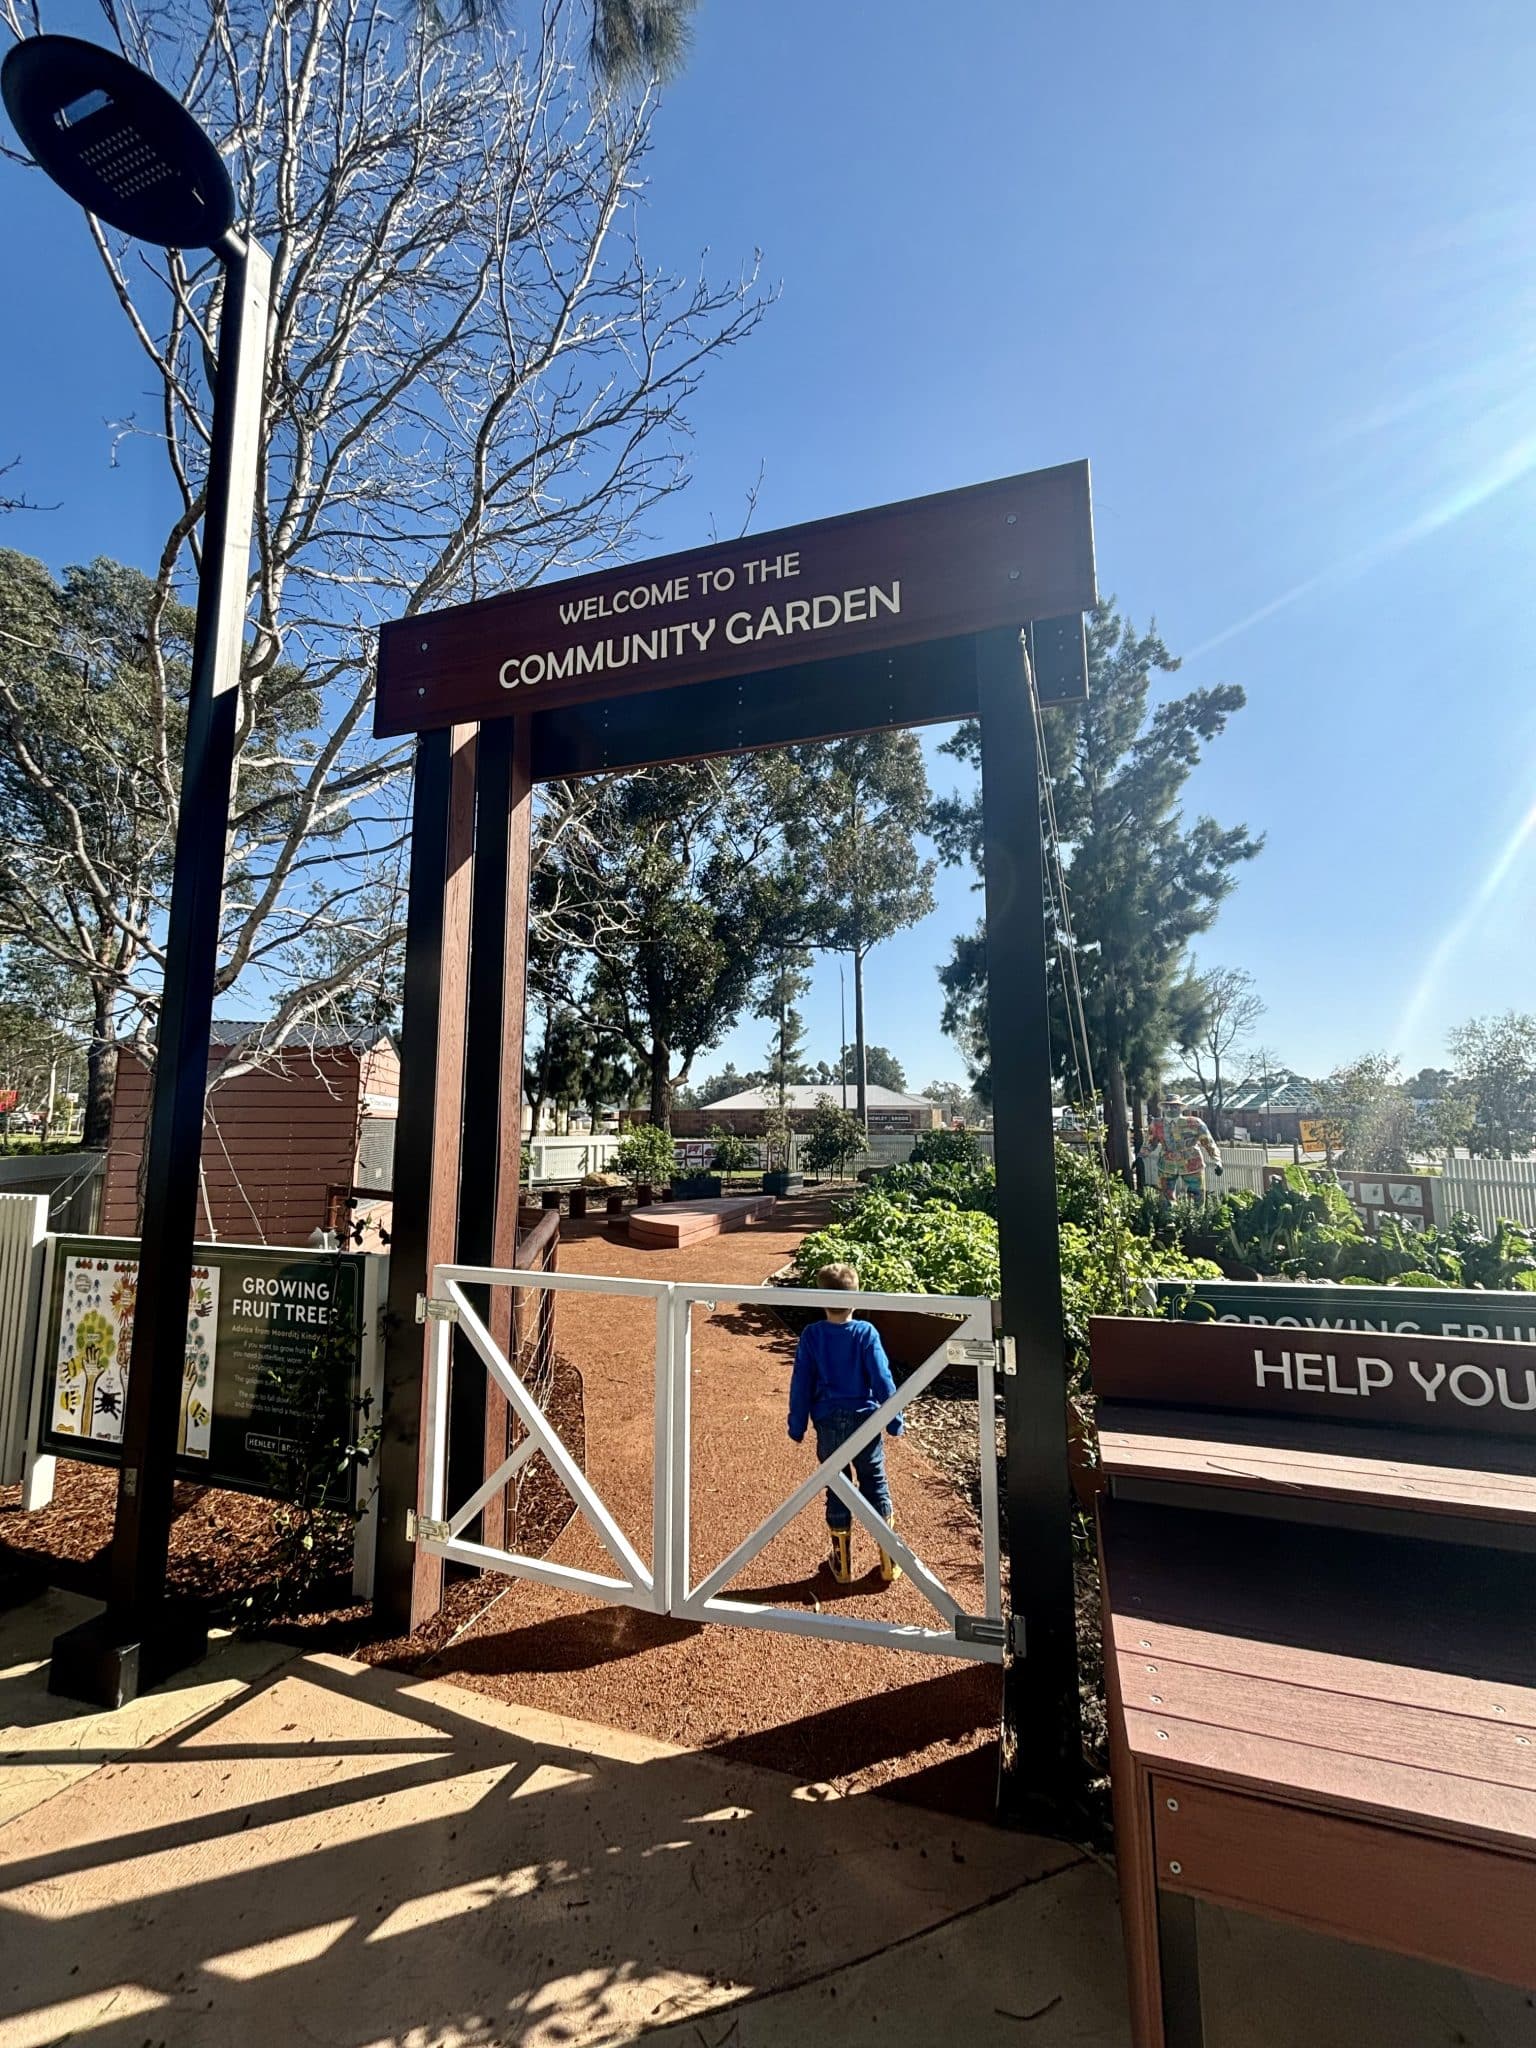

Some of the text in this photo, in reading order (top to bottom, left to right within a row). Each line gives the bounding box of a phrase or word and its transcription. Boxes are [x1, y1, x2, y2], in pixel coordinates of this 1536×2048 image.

[559, 552, 800, 626] WELCOME TO THE
[498, 581, 901, 689] COMMUNITY GARDEN
[242, 1276, 330, 1301] GROWING
[232, 1299, 280, 1320] FRUIT
[232, 1324, 254, 1334] Advice
[254, 1326, 270, 1335] from
[1254, 1350, 1536, 1411] HELP YOU
[249, 1438, 276, 1449] HENLEY
